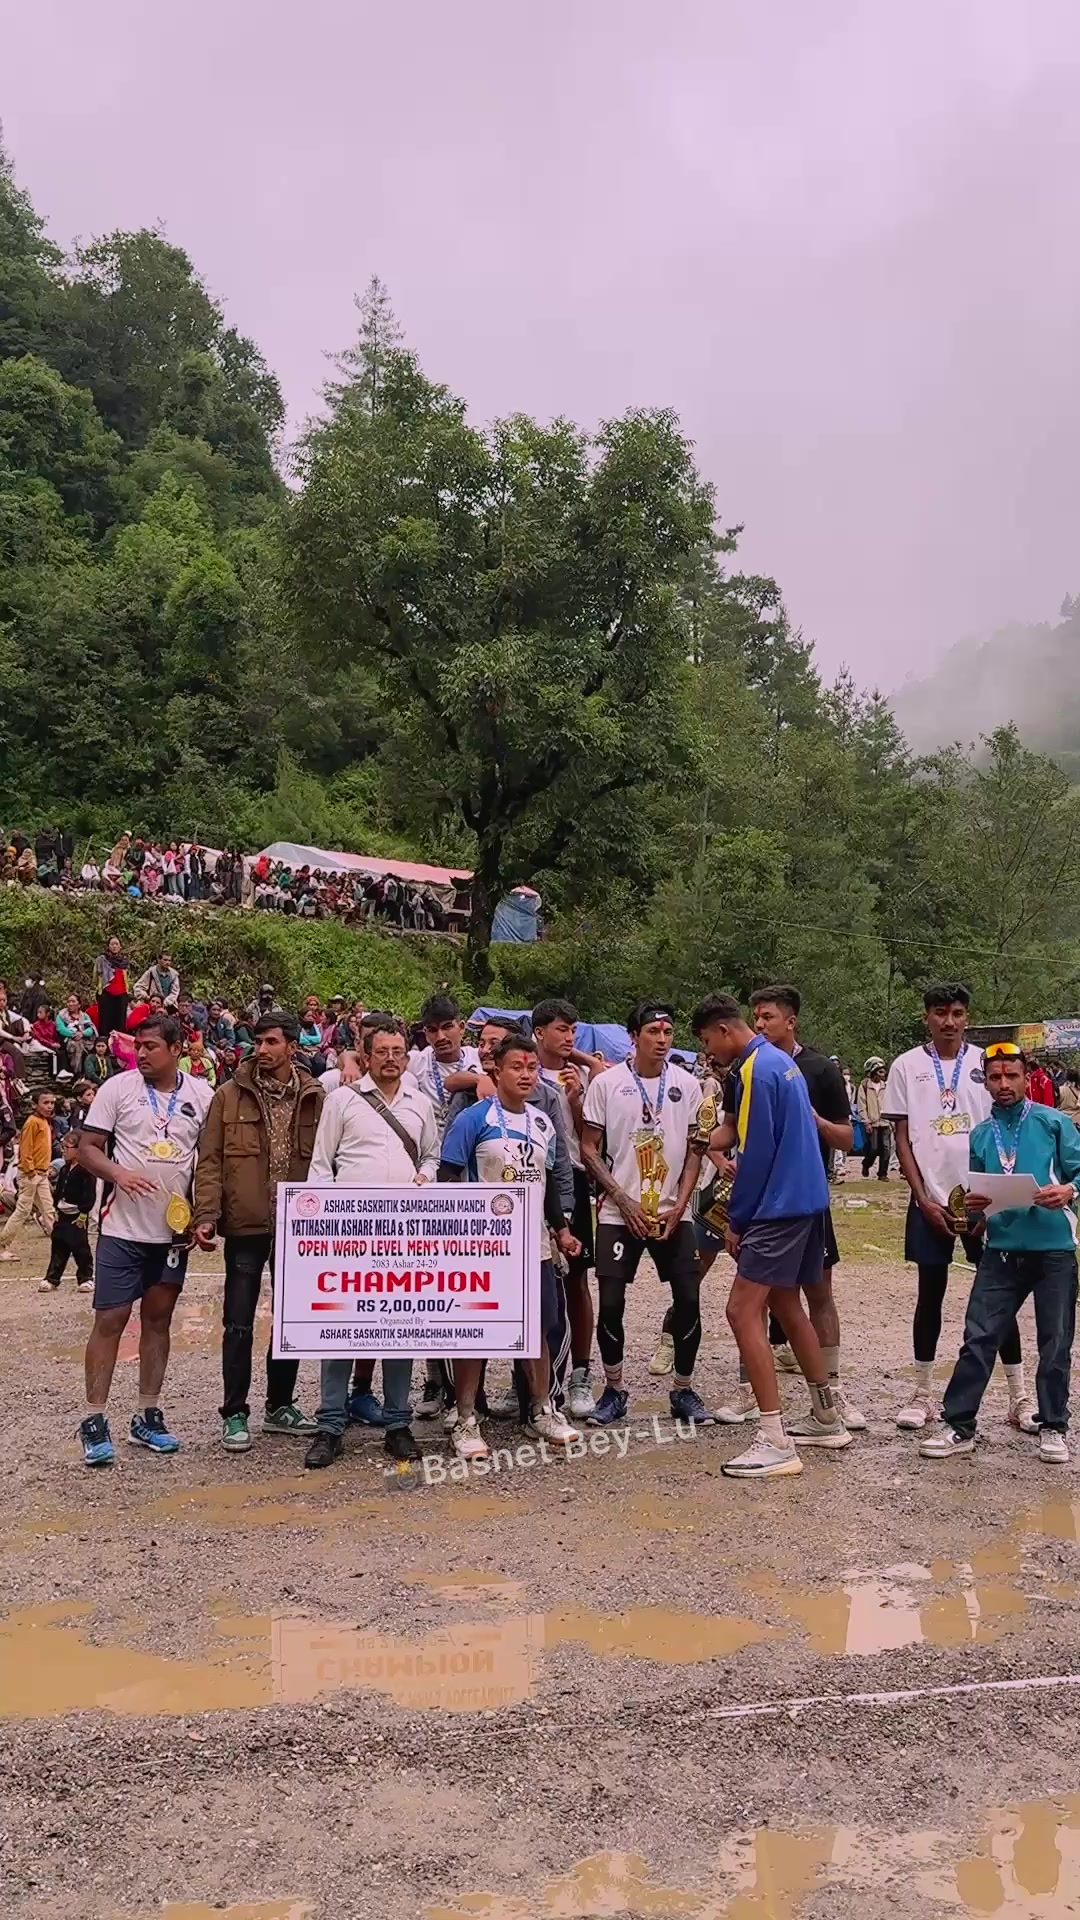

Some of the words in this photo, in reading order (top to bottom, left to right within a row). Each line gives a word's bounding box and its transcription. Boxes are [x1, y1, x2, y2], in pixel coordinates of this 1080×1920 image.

[517, 1142, 535, 1168] 12
[323, 1199, 356, 1213] ASHARE
[357, 1199, 399, 1213] SASKRITIK
[400, 1199, 455, 1213] SAMRACHHAN
[457, 1199, 486, 1213] MANCH
[291, 1219, 340, 1237] YATIHASHIK
[341, 1219, 373, 1237] ASHARE
[374, 1219, 396, 1237] MELA
[397, 1220, 404, 1237] &
[405, 1219, 420, 1236] 1ST
[422, 1219, 469, 1236] TARAKHOLA
[470, 1219, 512, 1236] CUP-2083
[297, 1240, 329, 1257] OPEN
[332, 1240, 368, 1258] WARD
[371, 1240, 403, 1257] LEVEL
[407, 1240, 439, 1257] MEN'S
[443, 1240, 511, 1258] VOLLEYBALL
[612, 1241, 625, 1261] 9
[166, 1248, 180, 1269] 8
[371, 1259, 390, 1269] 2083
[392, 1259, 414, 1269] Ashar
[416, 1259, 438, 1269] 24-29
[317, 1271, 491, 1293] CHAMPION
[356, 1300, 376, 1312] RS
[379, 1298, 461, 1315] 2,00,000/-
[380, 1317, 413, 1326] Organized
[319, 1328, 352, 1339] ASHARE
[353, 1328, 395, 1339] SASKRITIK
[397, 1328, 453, 1339] SAMRACHHAN
[454, 1328, 484, 1338] MANCH
